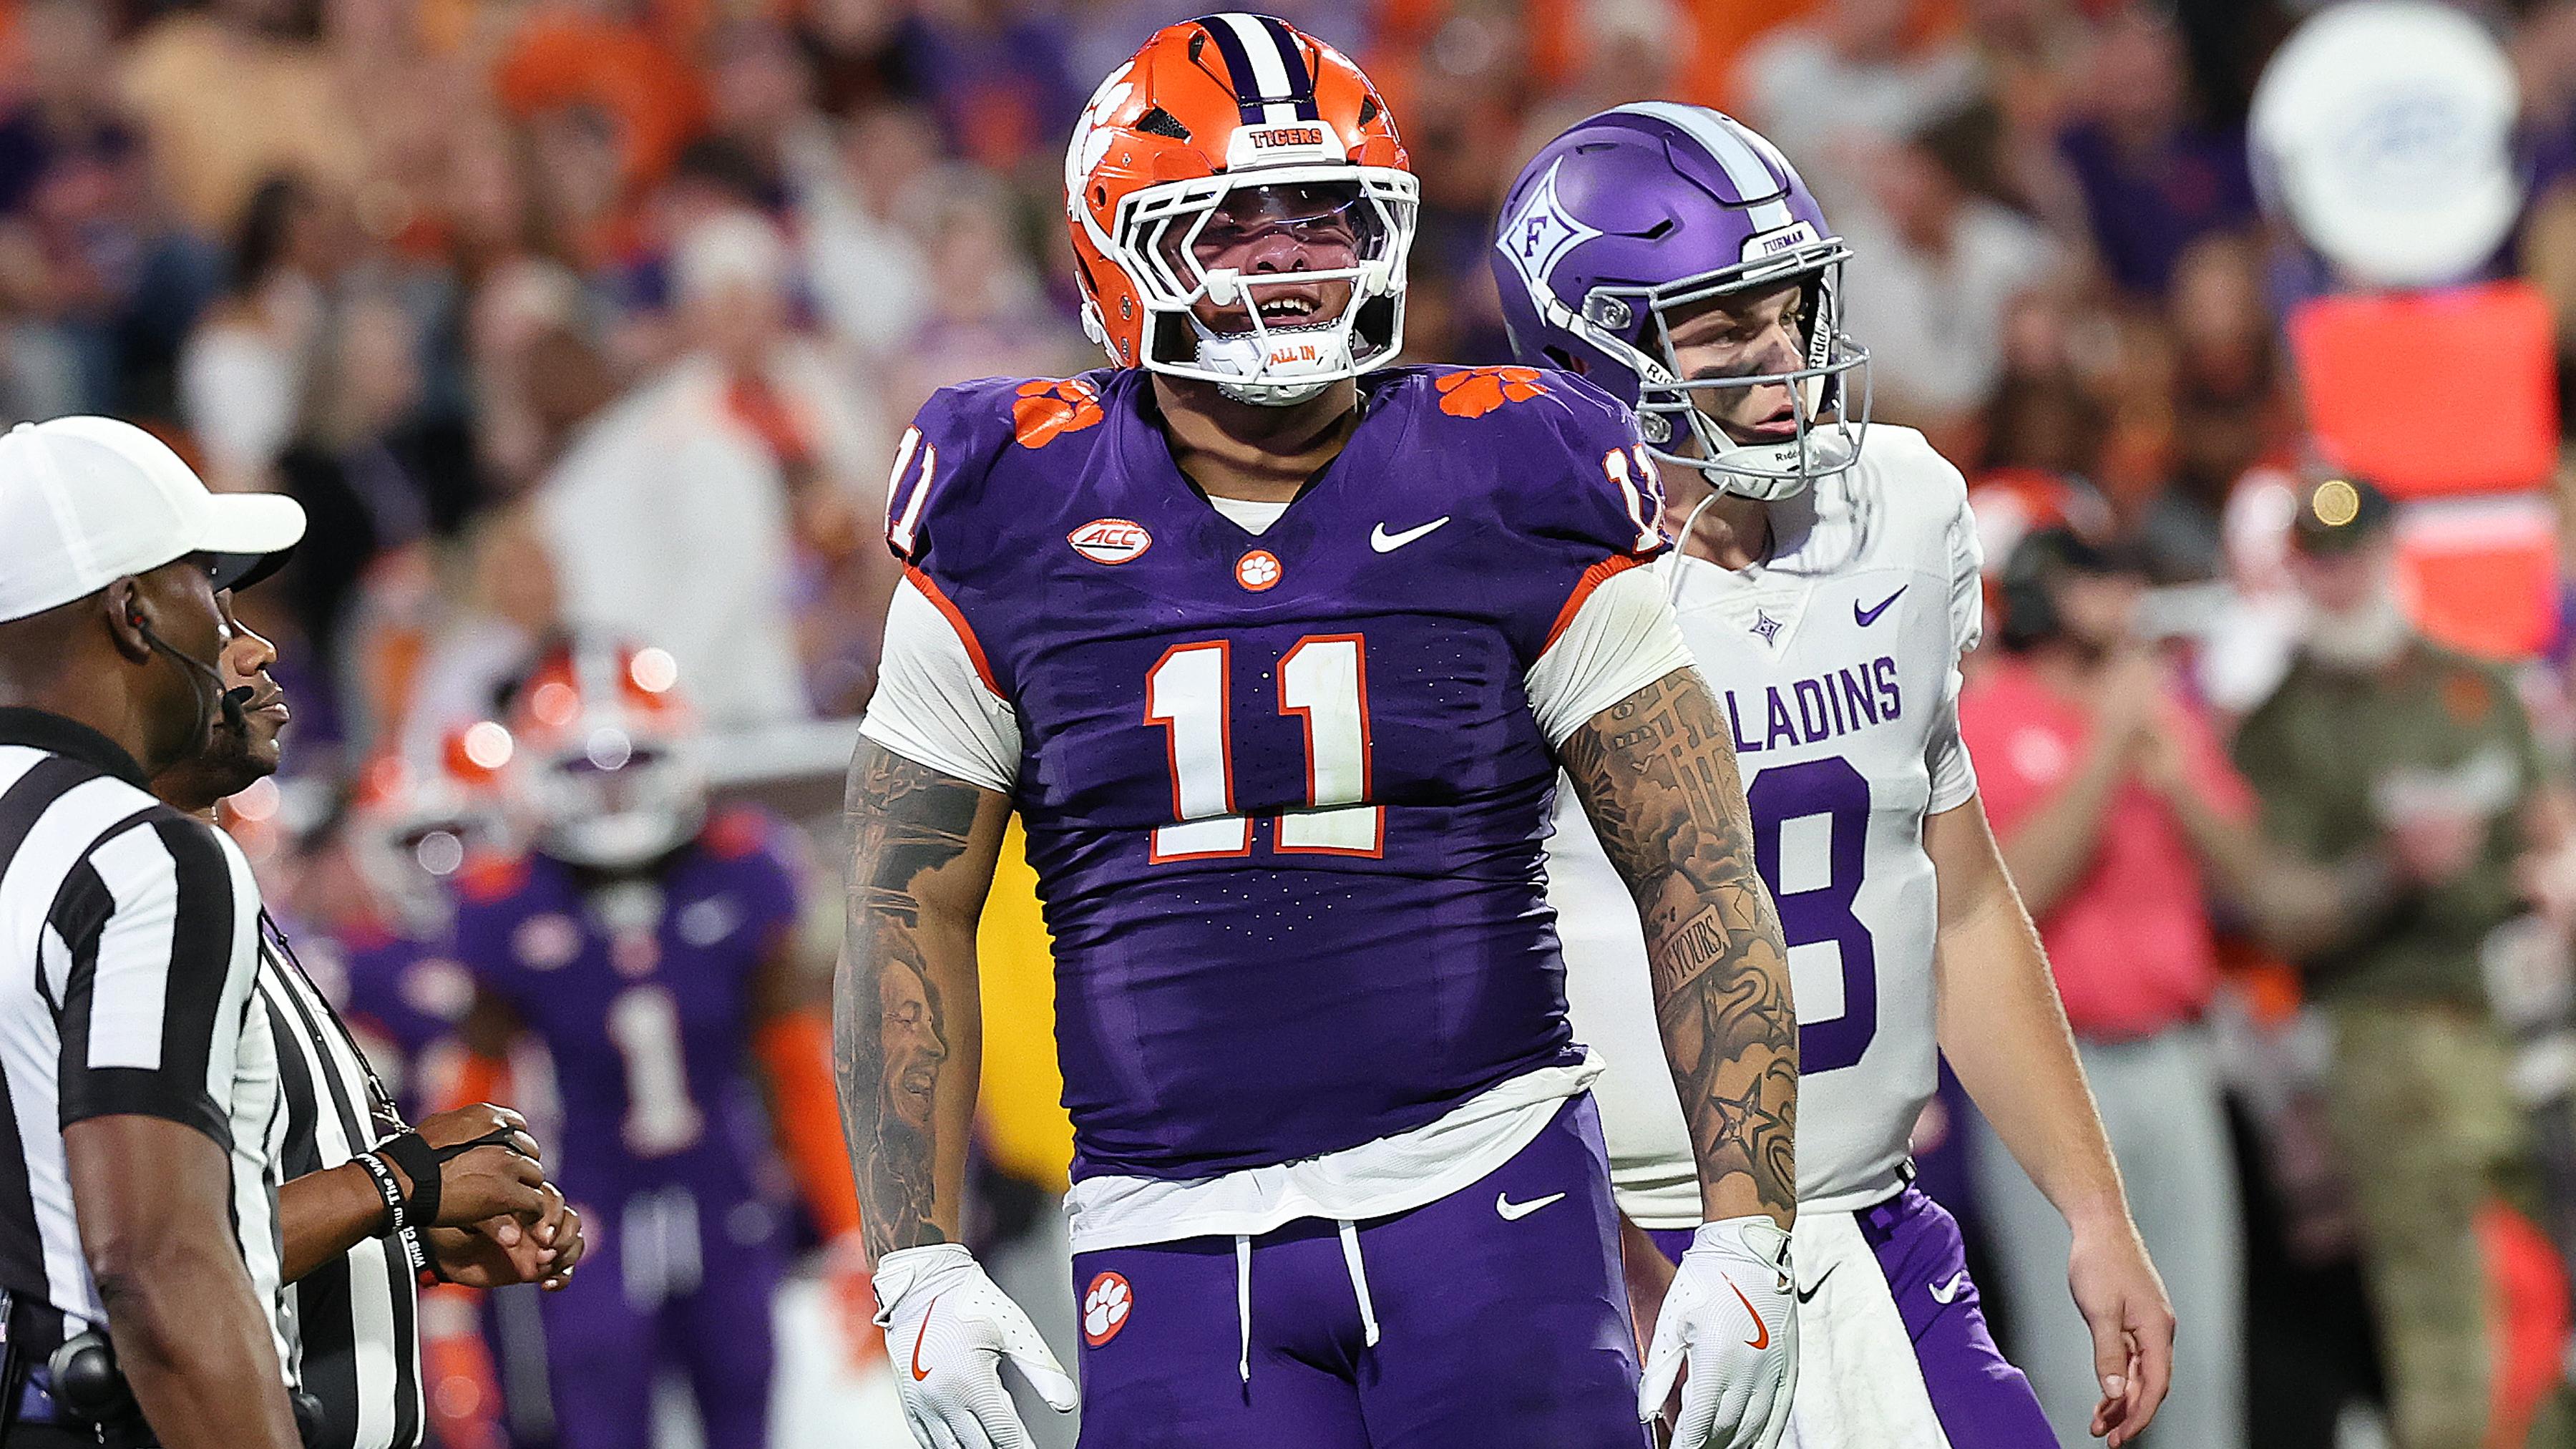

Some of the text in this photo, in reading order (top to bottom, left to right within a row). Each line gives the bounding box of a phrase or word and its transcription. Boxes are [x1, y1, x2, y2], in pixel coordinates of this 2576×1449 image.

[1249, 129, 1323, 148] TIGERS
[1524, 215, 1547, 258] F
[1269, 346, 1315, 366] ALL IN
[1080, 529, 1141, 545] ACC
[1725, 656, 1901, 753] LADINS
[1143, 633, 1385, 865] 11
[1747, 756, 1877, 1077] 8
[384, 1178, 400, 1206] The
